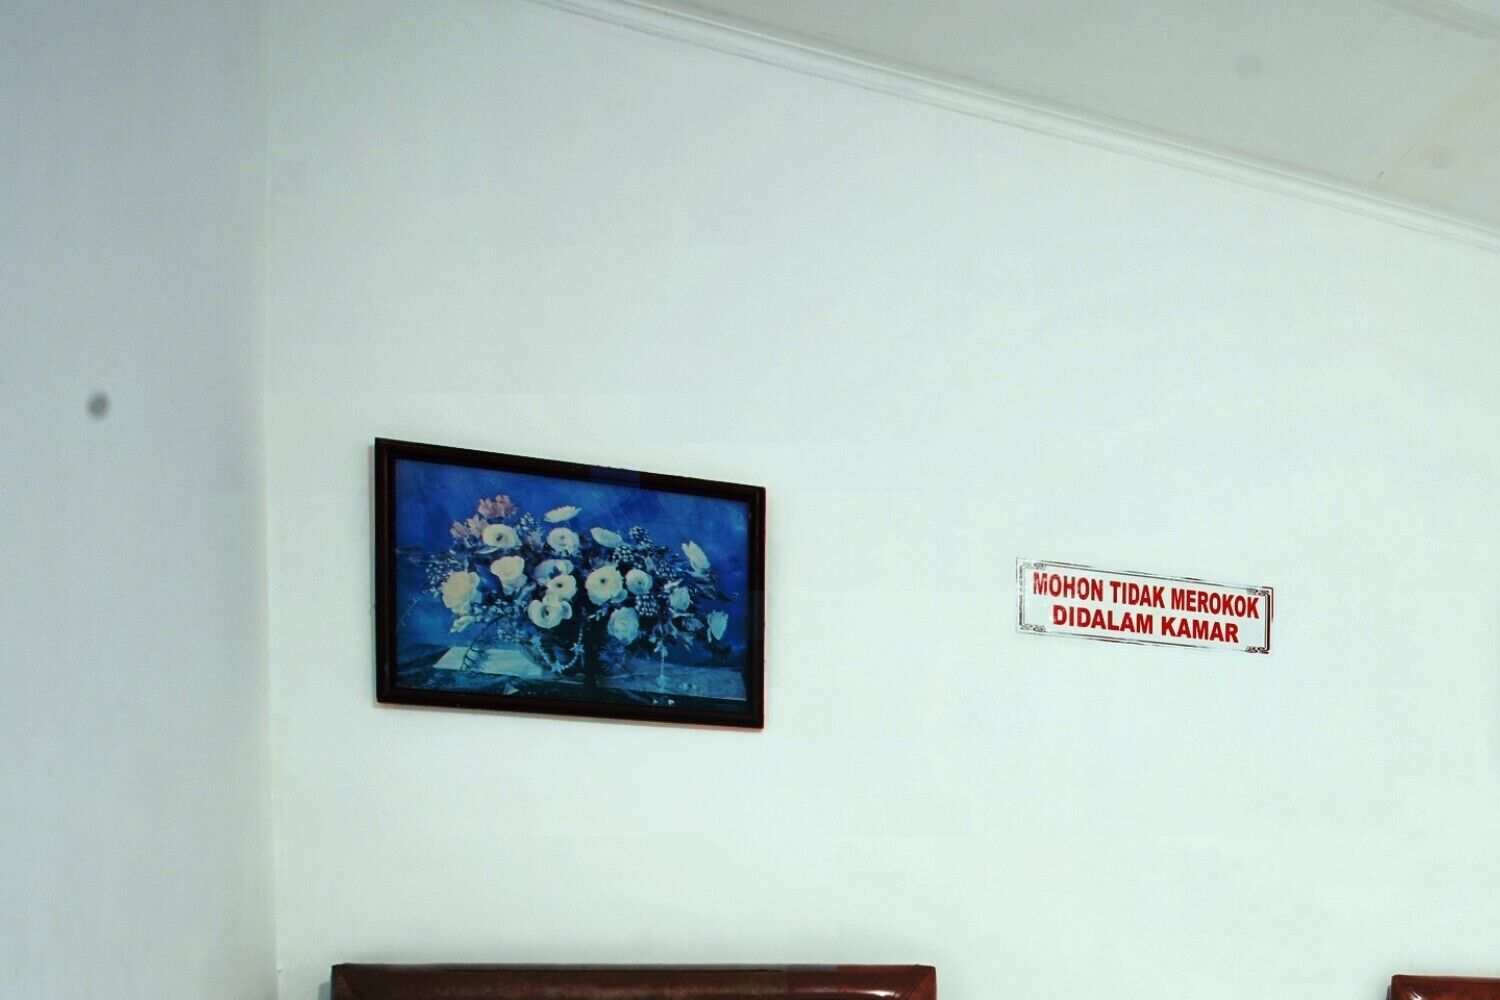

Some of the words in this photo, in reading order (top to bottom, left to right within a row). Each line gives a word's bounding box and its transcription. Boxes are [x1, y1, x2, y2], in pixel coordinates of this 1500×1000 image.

[1032, 571, 1104, 601] MOHON
[1109, 580, 1165, 608] TIDAK
[1171, 588, 1259, 619] MEROKOK
[1052, 604, 1153, 634] DIDALAM
[1161, 616, 1239, 643] KAMAR
